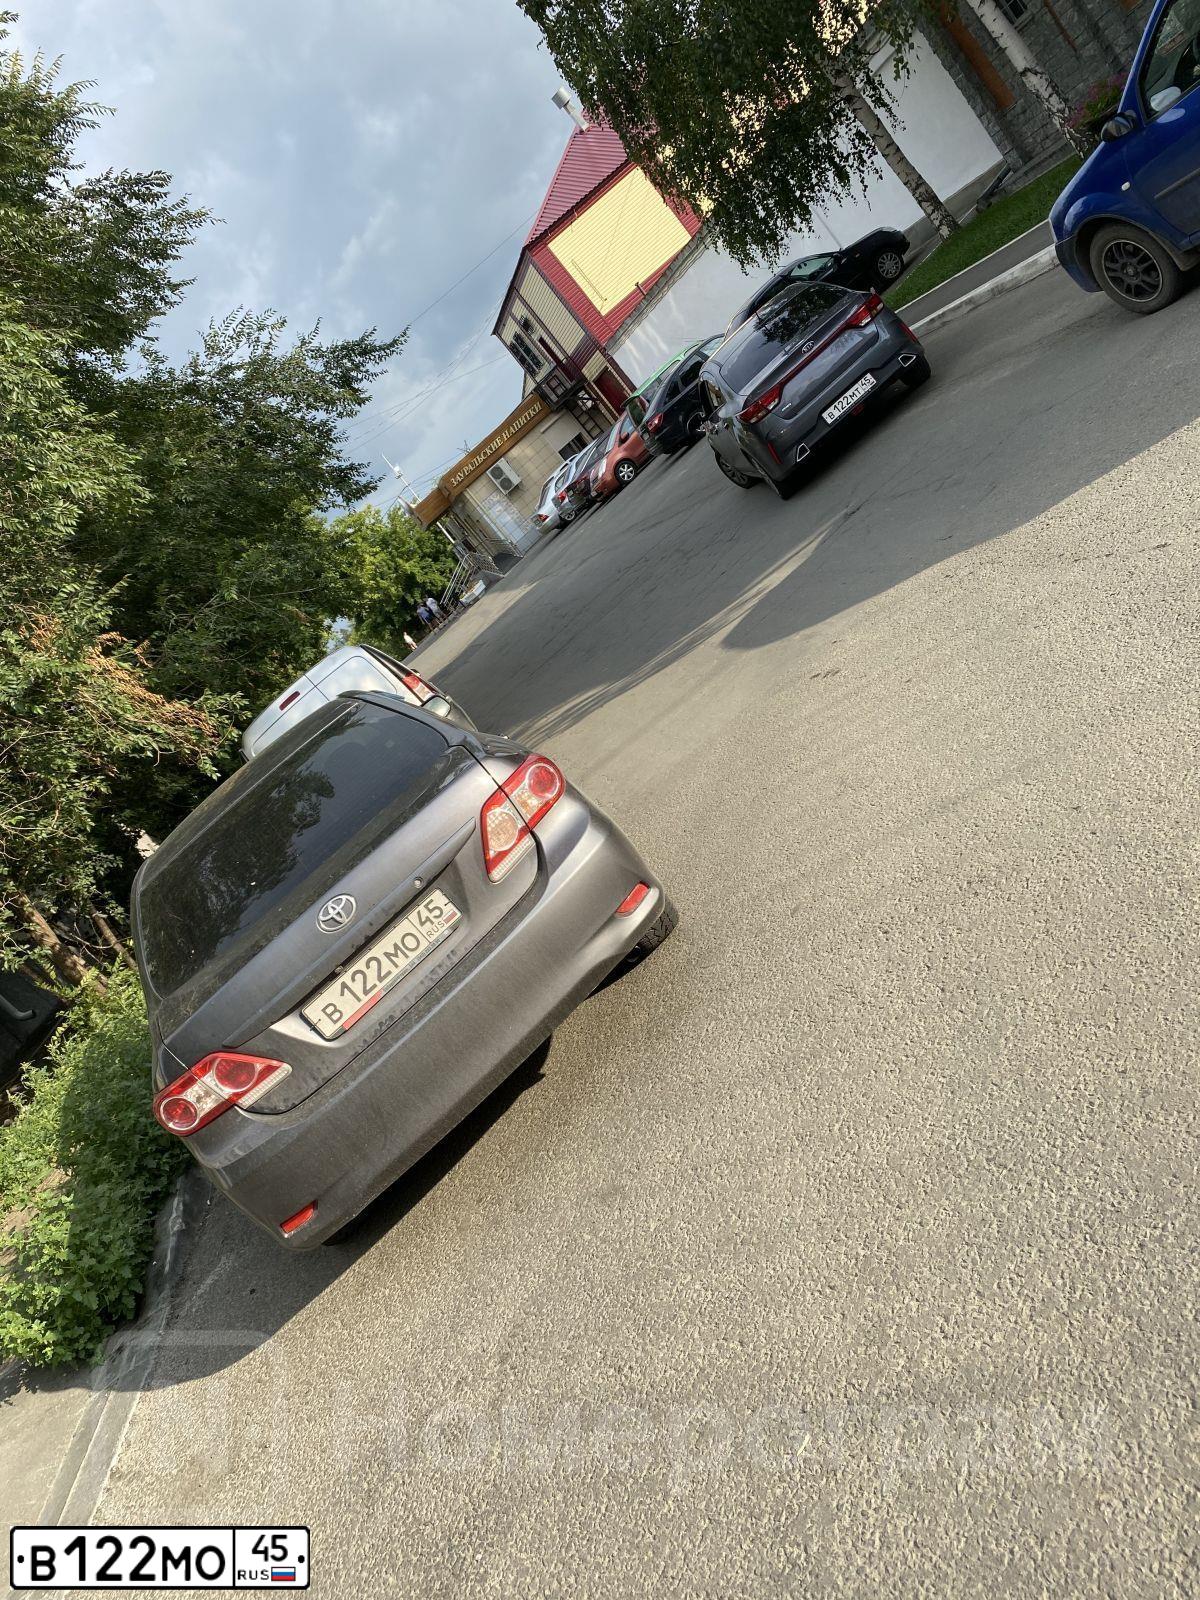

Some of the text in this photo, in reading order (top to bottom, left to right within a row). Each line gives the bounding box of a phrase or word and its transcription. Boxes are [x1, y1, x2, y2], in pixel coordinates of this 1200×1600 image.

[827, 376, 872, 420] В122МТ 45
[450, 401, 543, 487] ЗАУРАЛЬСКИЕ НАПИТКИ
[321, 932, 421, 1025] В122МО
[417, 898, 444, 928] 45
[426, 920, 445, 939] RUS
